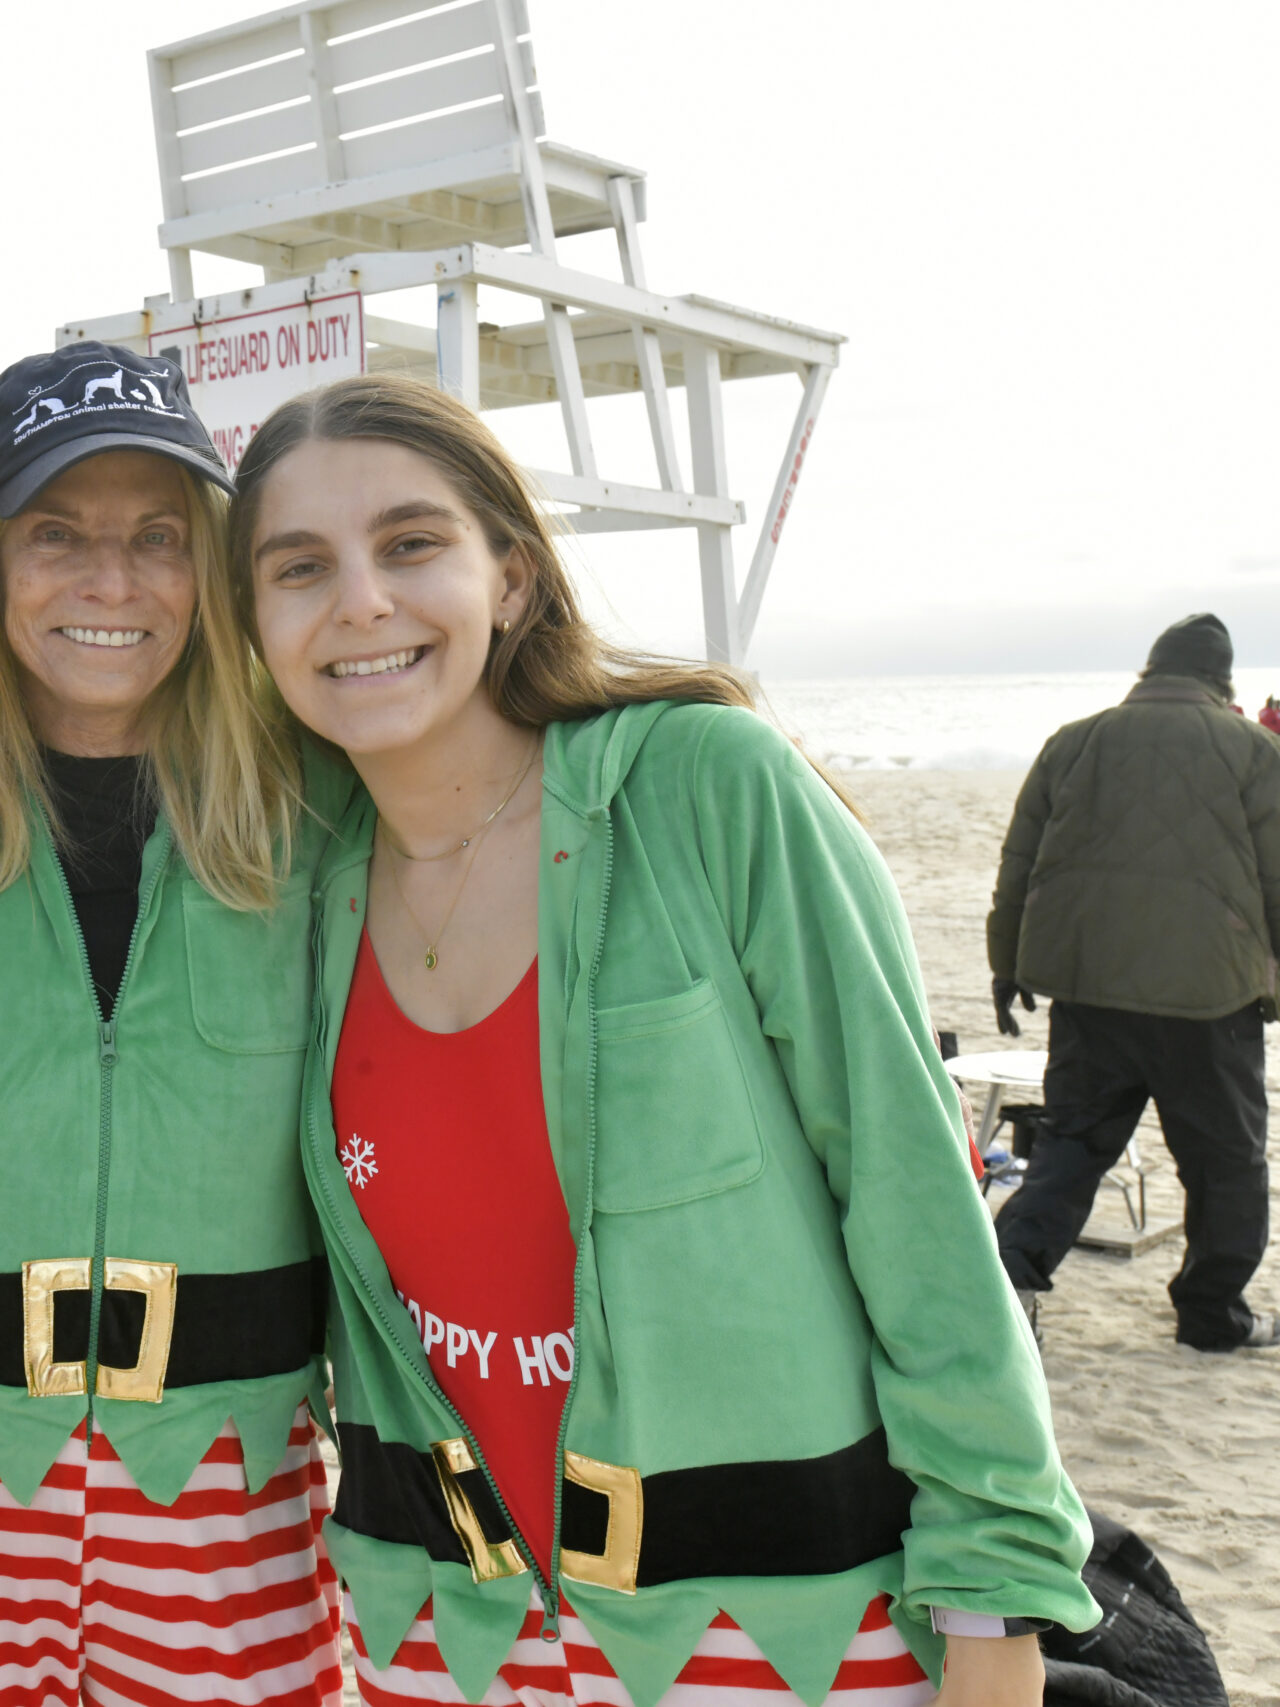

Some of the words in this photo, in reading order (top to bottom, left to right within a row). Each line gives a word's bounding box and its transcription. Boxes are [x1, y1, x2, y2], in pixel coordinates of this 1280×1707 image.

[185, 330, 270, 384] LIFEGUARD
[277, 323, 300, 369] ON
[307, 313, 350, 363] DUTY
[72, 403, 106, 416] animal
[107, 402, 141, 410] shelter
[513, 1326, 575, 1387] HO
